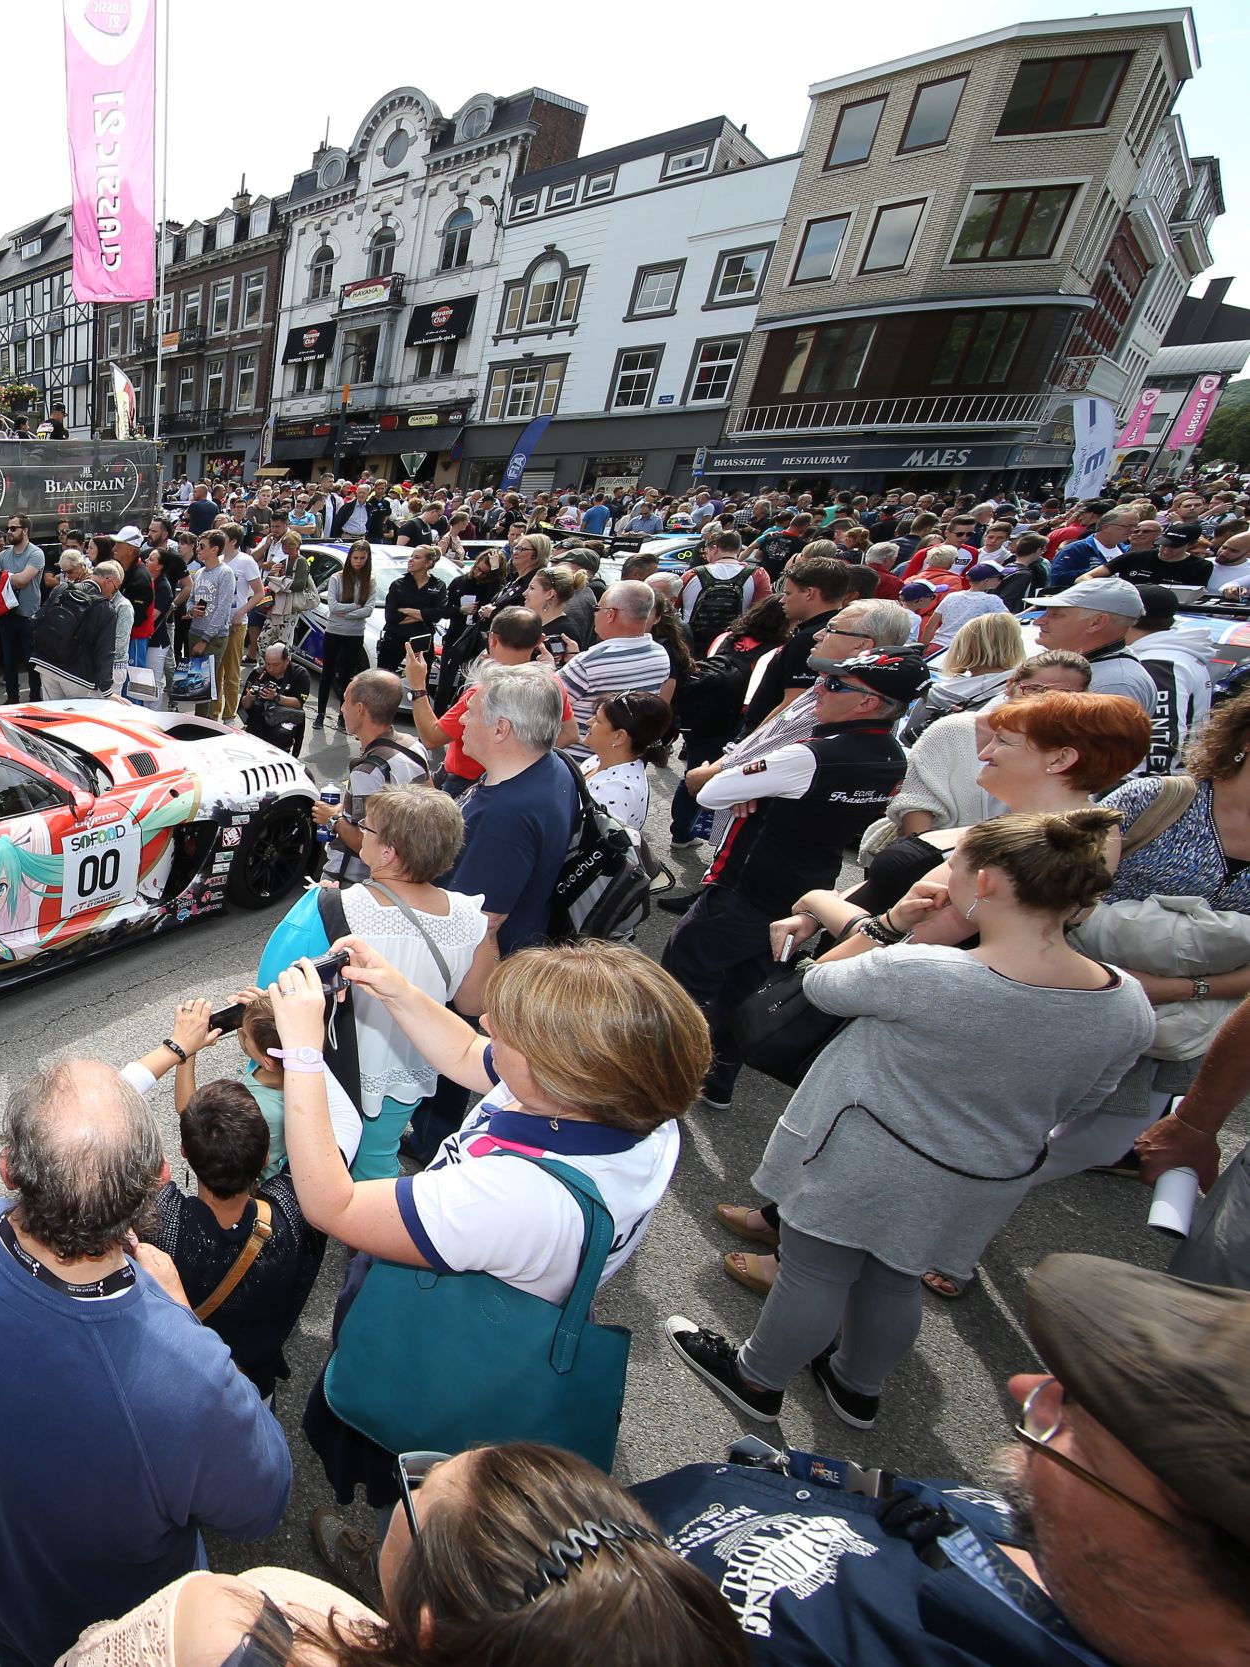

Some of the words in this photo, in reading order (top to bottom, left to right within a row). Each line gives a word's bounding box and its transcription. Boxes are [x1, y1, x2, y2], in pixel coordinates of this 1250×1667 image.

[1185, 409, 1204, 437] CLASSIC
[1197, 398, 1209, 408] 21
[178, 436, 233, 452] OPTIQUE
[714, 457, 767, 467] BRASSERIE
[782, 455, 850, 465] RESTAURANT
[902, 450, 972, 467] MAES
[44, 477, 126, 493] BLANCPAIN
[58, 503, 73, 515] GT
[76, 500, 112, 514] SERIES
[1150, 690, 1171, 777] BENTLE
[78, 848, 120, 898] 00
[557, 851, 603, 894] Quechua
